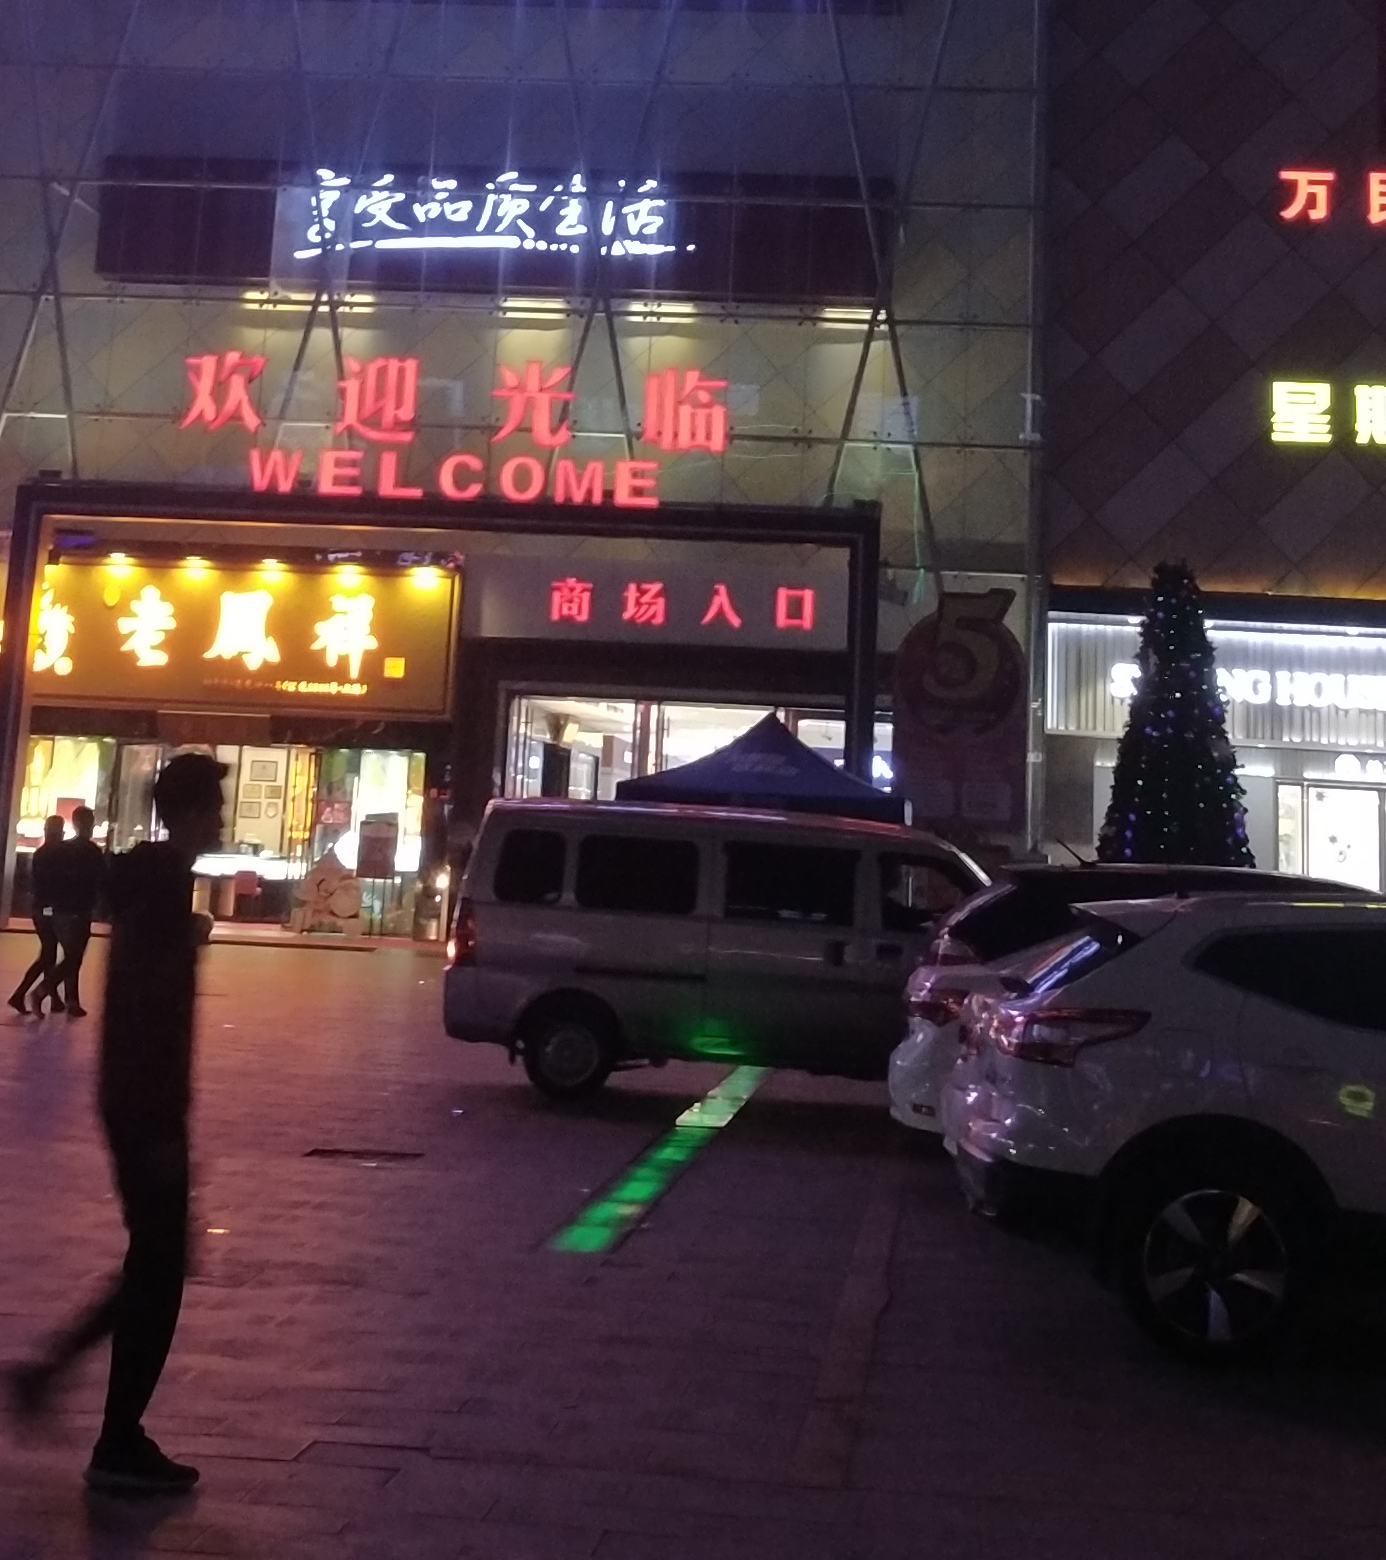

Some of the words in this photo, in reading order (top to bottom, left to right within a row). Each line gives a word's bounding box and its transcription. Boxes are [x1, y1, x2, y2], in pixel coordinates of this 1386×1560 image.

[179, 349, 730, 455] 欢迎光临
[249, 447, 660, 509] WELCOME
[549, 575, 819, 632] 商场入口
